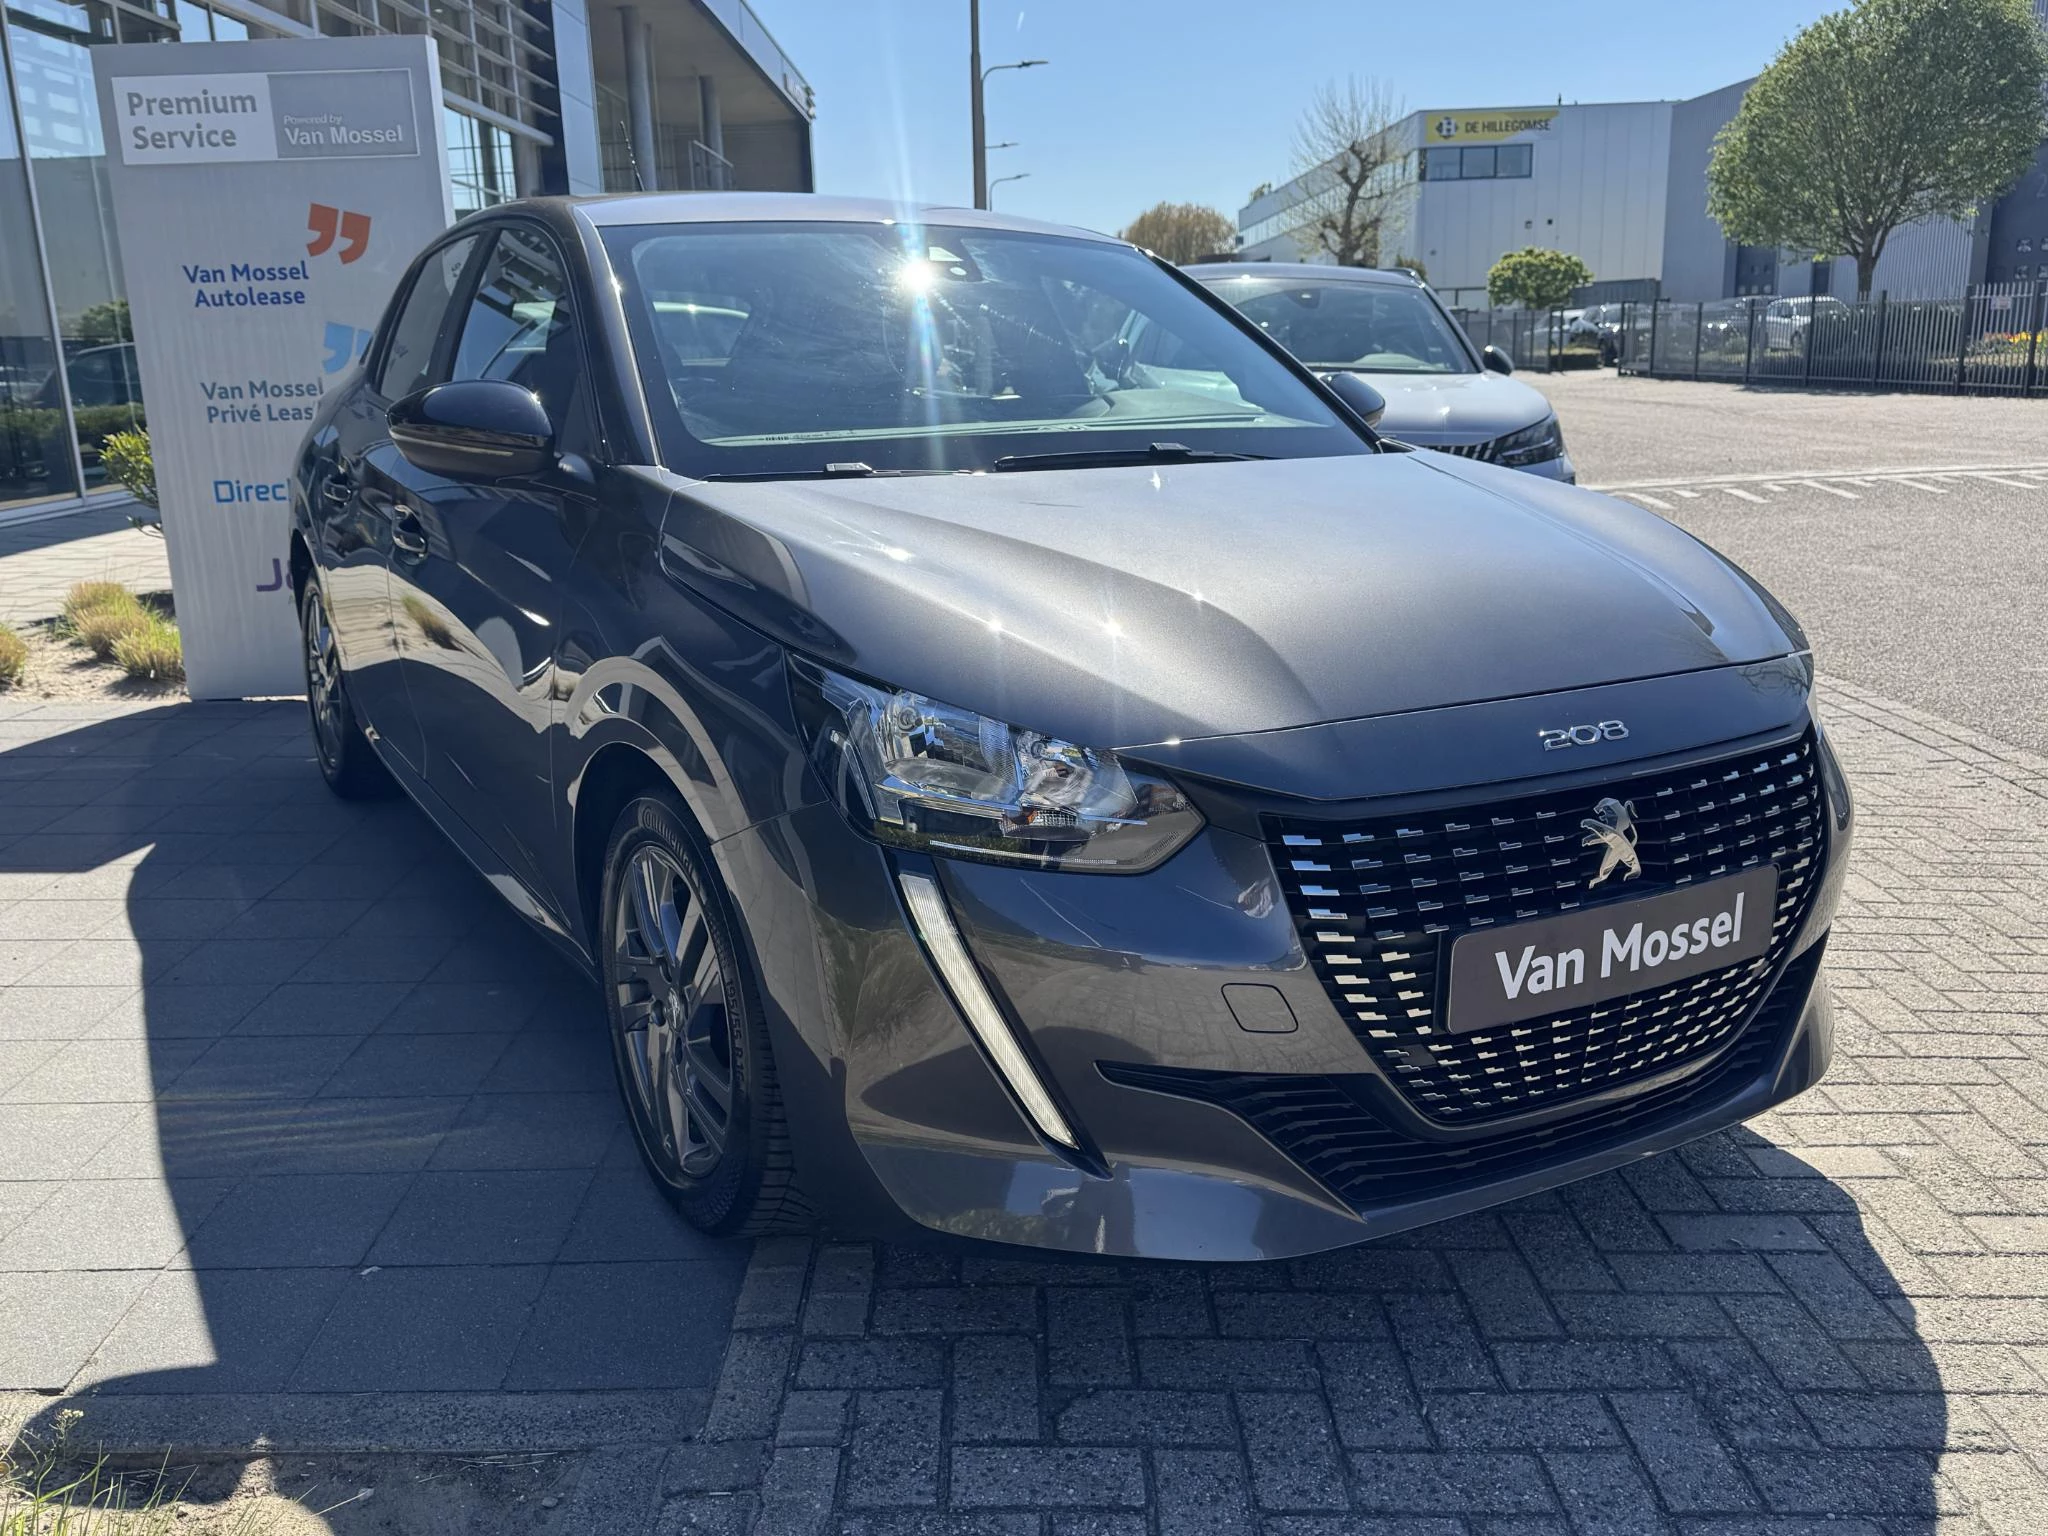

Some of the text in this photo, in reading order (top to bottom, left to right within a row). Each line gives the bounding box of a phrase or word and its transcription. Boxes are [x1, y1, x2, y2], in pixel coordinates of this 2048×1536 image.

[127, 89, 257, 117] Premium
[283, 113, 343, 125] Powered by
[1465, 121, 1479, 134] DE
[132, 123, 237, 150] Service
[284, 124, 403, 145] Van Mossel
[183, 260, 310, 284] Van Mossel
[195, 286, 306, 308] Autolease
[200, 377, 324, 400] Van Mossel
[207, 401, 261, 424] Privé
[213, 478, 291, 503] Direc
[1539, 719, 1630, 752] 208
[1495, 891, 1745, 1001] Van Mossel
